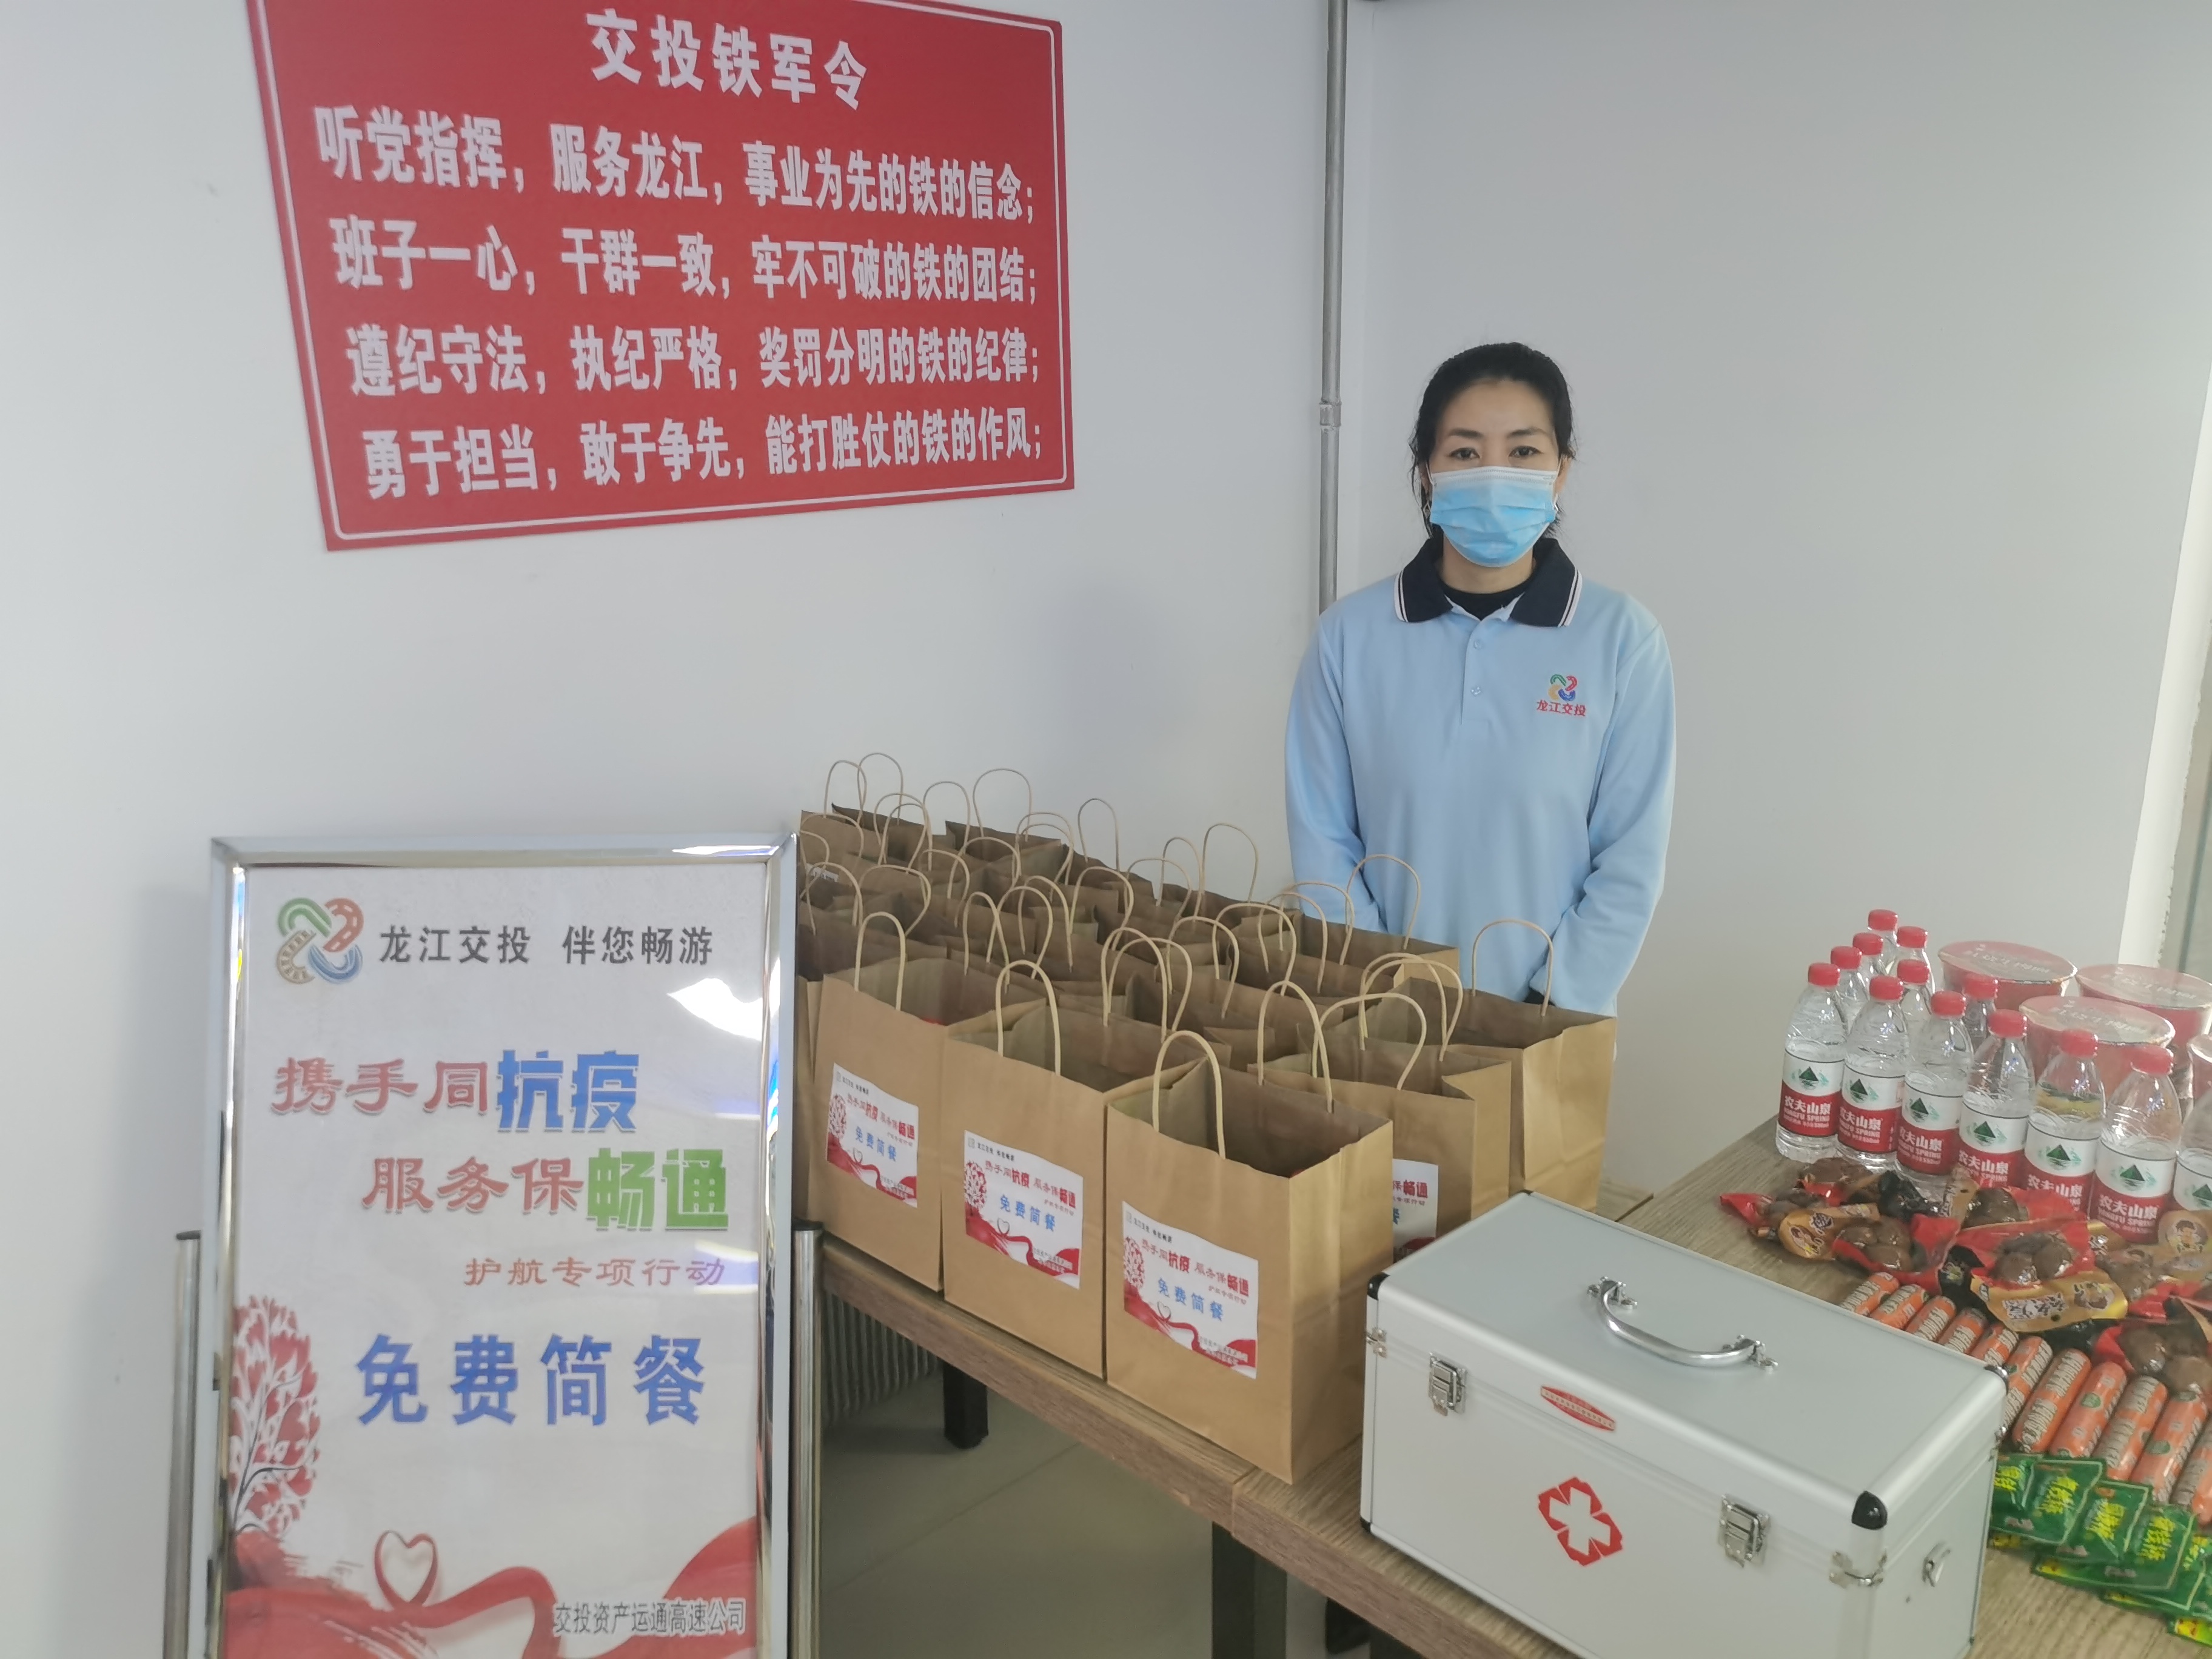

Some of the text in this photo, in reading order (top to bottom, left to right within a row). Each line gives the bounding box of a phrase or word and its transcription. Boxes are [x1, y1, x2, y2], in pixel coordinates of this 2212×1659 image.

[586, 8, 867, 110] 交投铁军令
[314, 105, 1033, 224] 听党指挥，服务龙江，事业为先的铁的信念；
[329, 214, 1036, 305] 班子一心，干群一致，牢不可破的铁的团结；
[346, 323, 1038, 397] 遵纪守法，执纪严格，奖罚分明的铁的纪律；
[362, 407, 1041, 500] 勇于担当，敢于争先，能打胜仗的铁的作风；
[1536, 699, 1586, 717] 龙江交投
[380, 925, 713, 965] 龙江交投 伴您畅游
[272, 1049, 640, 1132] 携手同抗疫
[1785, 1096, 1831, 1116] 农夫山泉
[1840, 1107, 1882, 1131] 农夫山泉
[1959, 1150, 2009, 1175] 农夫山泉
[363, 1147, 729, 1231] 服务保畅通
[1000, 1194, 1056, 1232] 免费简餐
[463, 1257, 725, 1287] 护航专项行动
[1158, 1277, 1223, 1321] 免费简餐
[356, 1333, 706, 1427] 免费简餐
[552, 1595, 746, 1637] 交投资产运通高速公司
